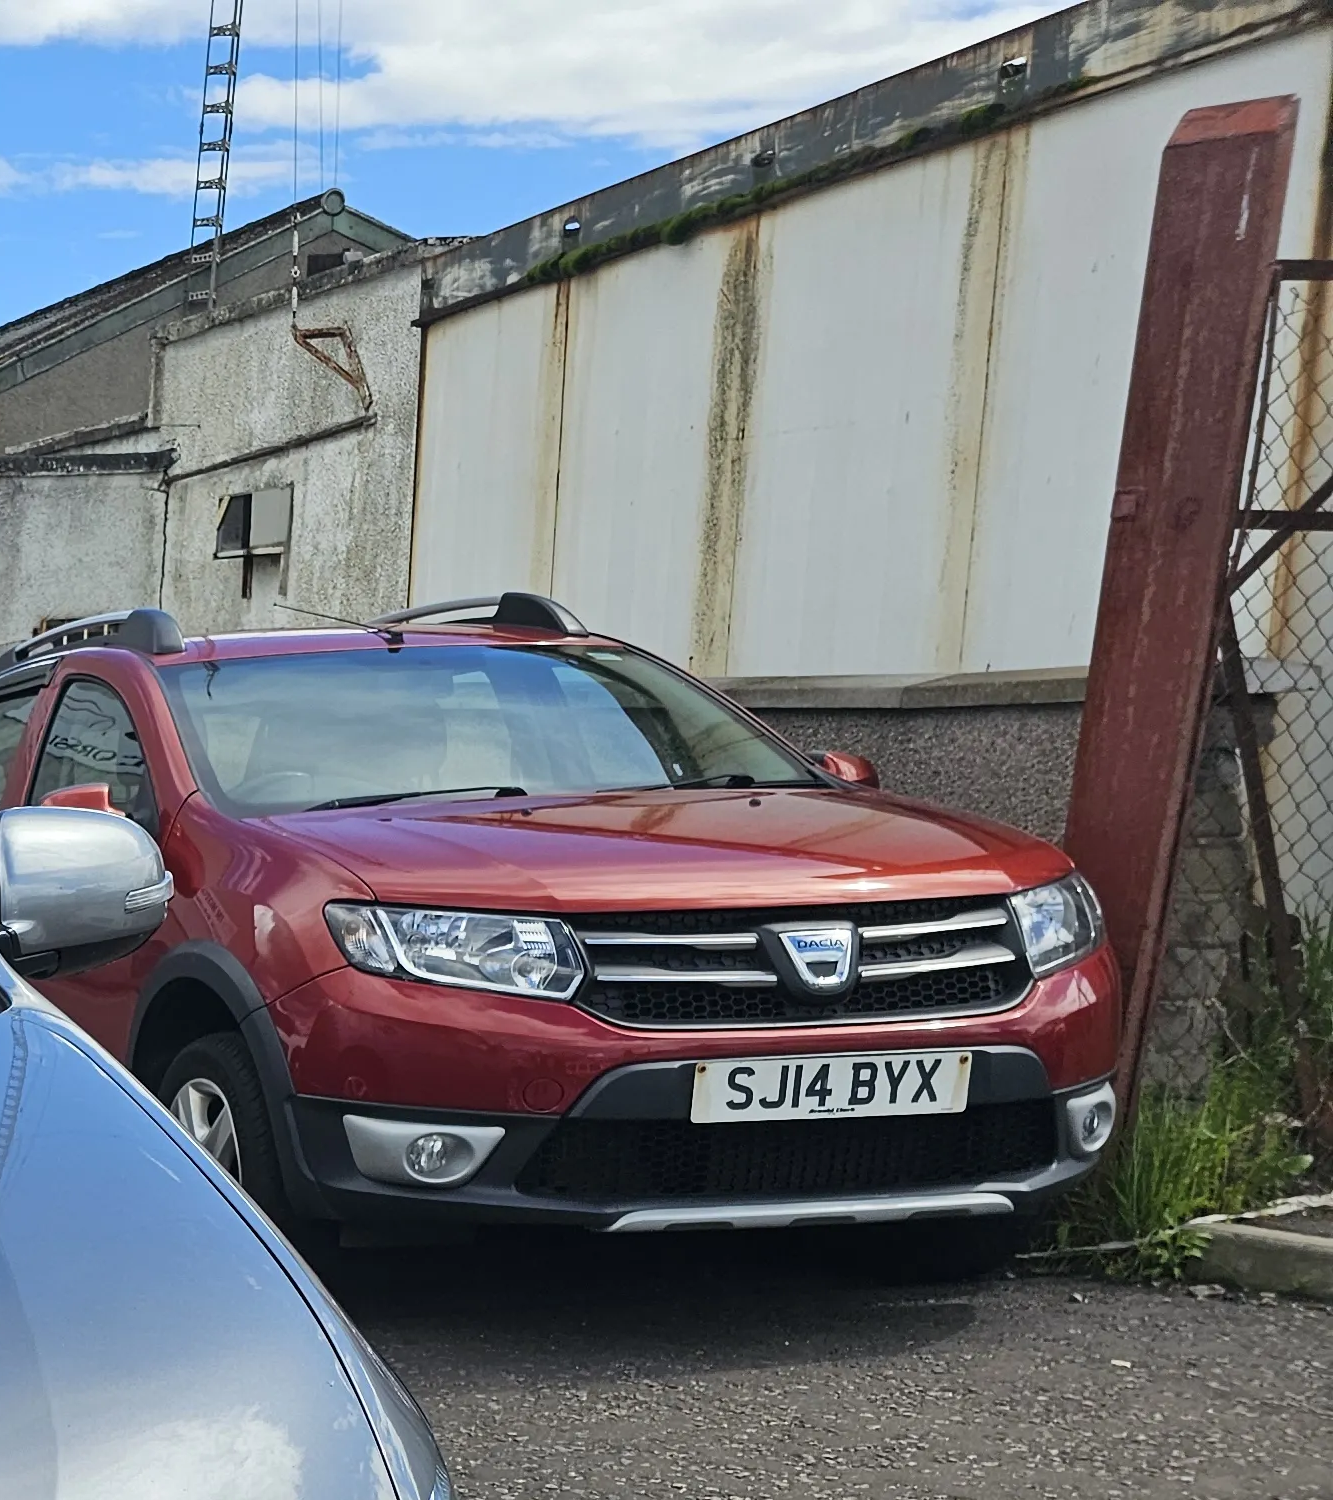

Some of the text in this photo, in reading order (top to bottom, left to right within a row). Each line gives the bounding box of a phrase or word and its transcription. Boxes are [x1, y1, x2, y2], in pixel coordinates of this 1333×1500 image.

[797, 938, 845, 949] DACIA
[725, 1058, 942, 1111] SJ14 BYX
